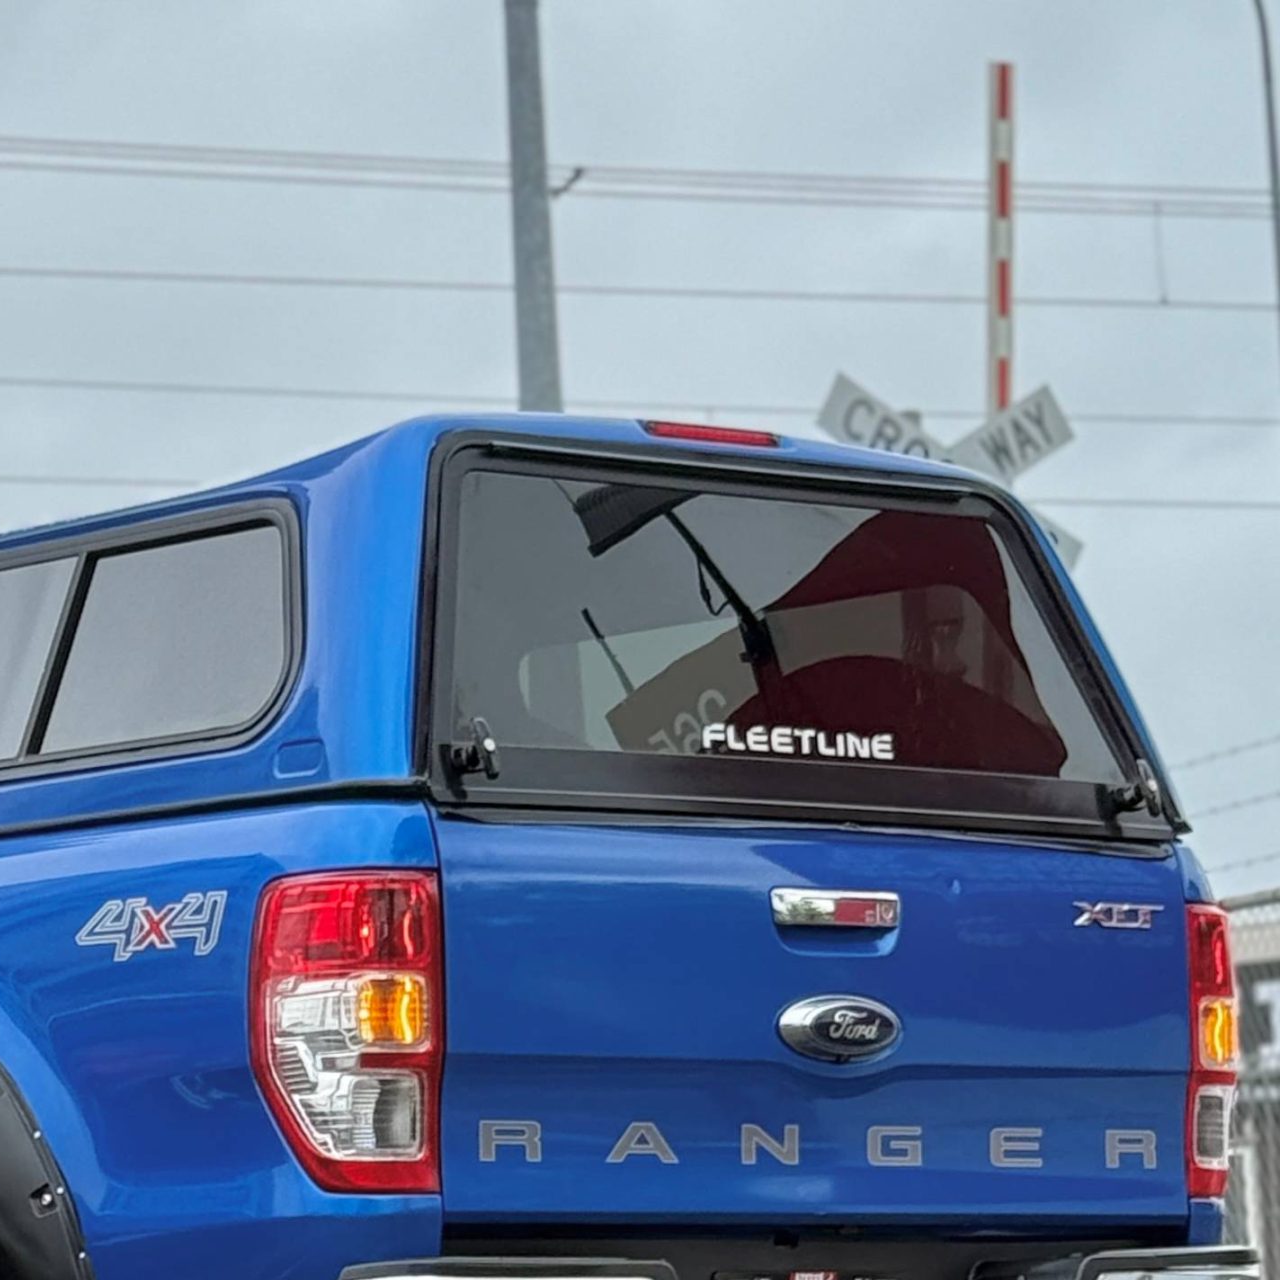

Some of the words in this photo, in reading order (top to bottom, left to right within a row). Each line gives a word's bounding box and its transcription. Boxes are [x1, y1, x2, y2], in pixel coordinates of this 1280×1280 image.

[842, 398, 953, 463] CRO
[978, 401, 1054, 474] WAY
[702, 722, 895, 761] FLEETLINE
[1071, 901, 1165, 929] XLT
[829, 1009, 879, 1042] Ford
[478, 1120, 1158, 1169] RANGER
